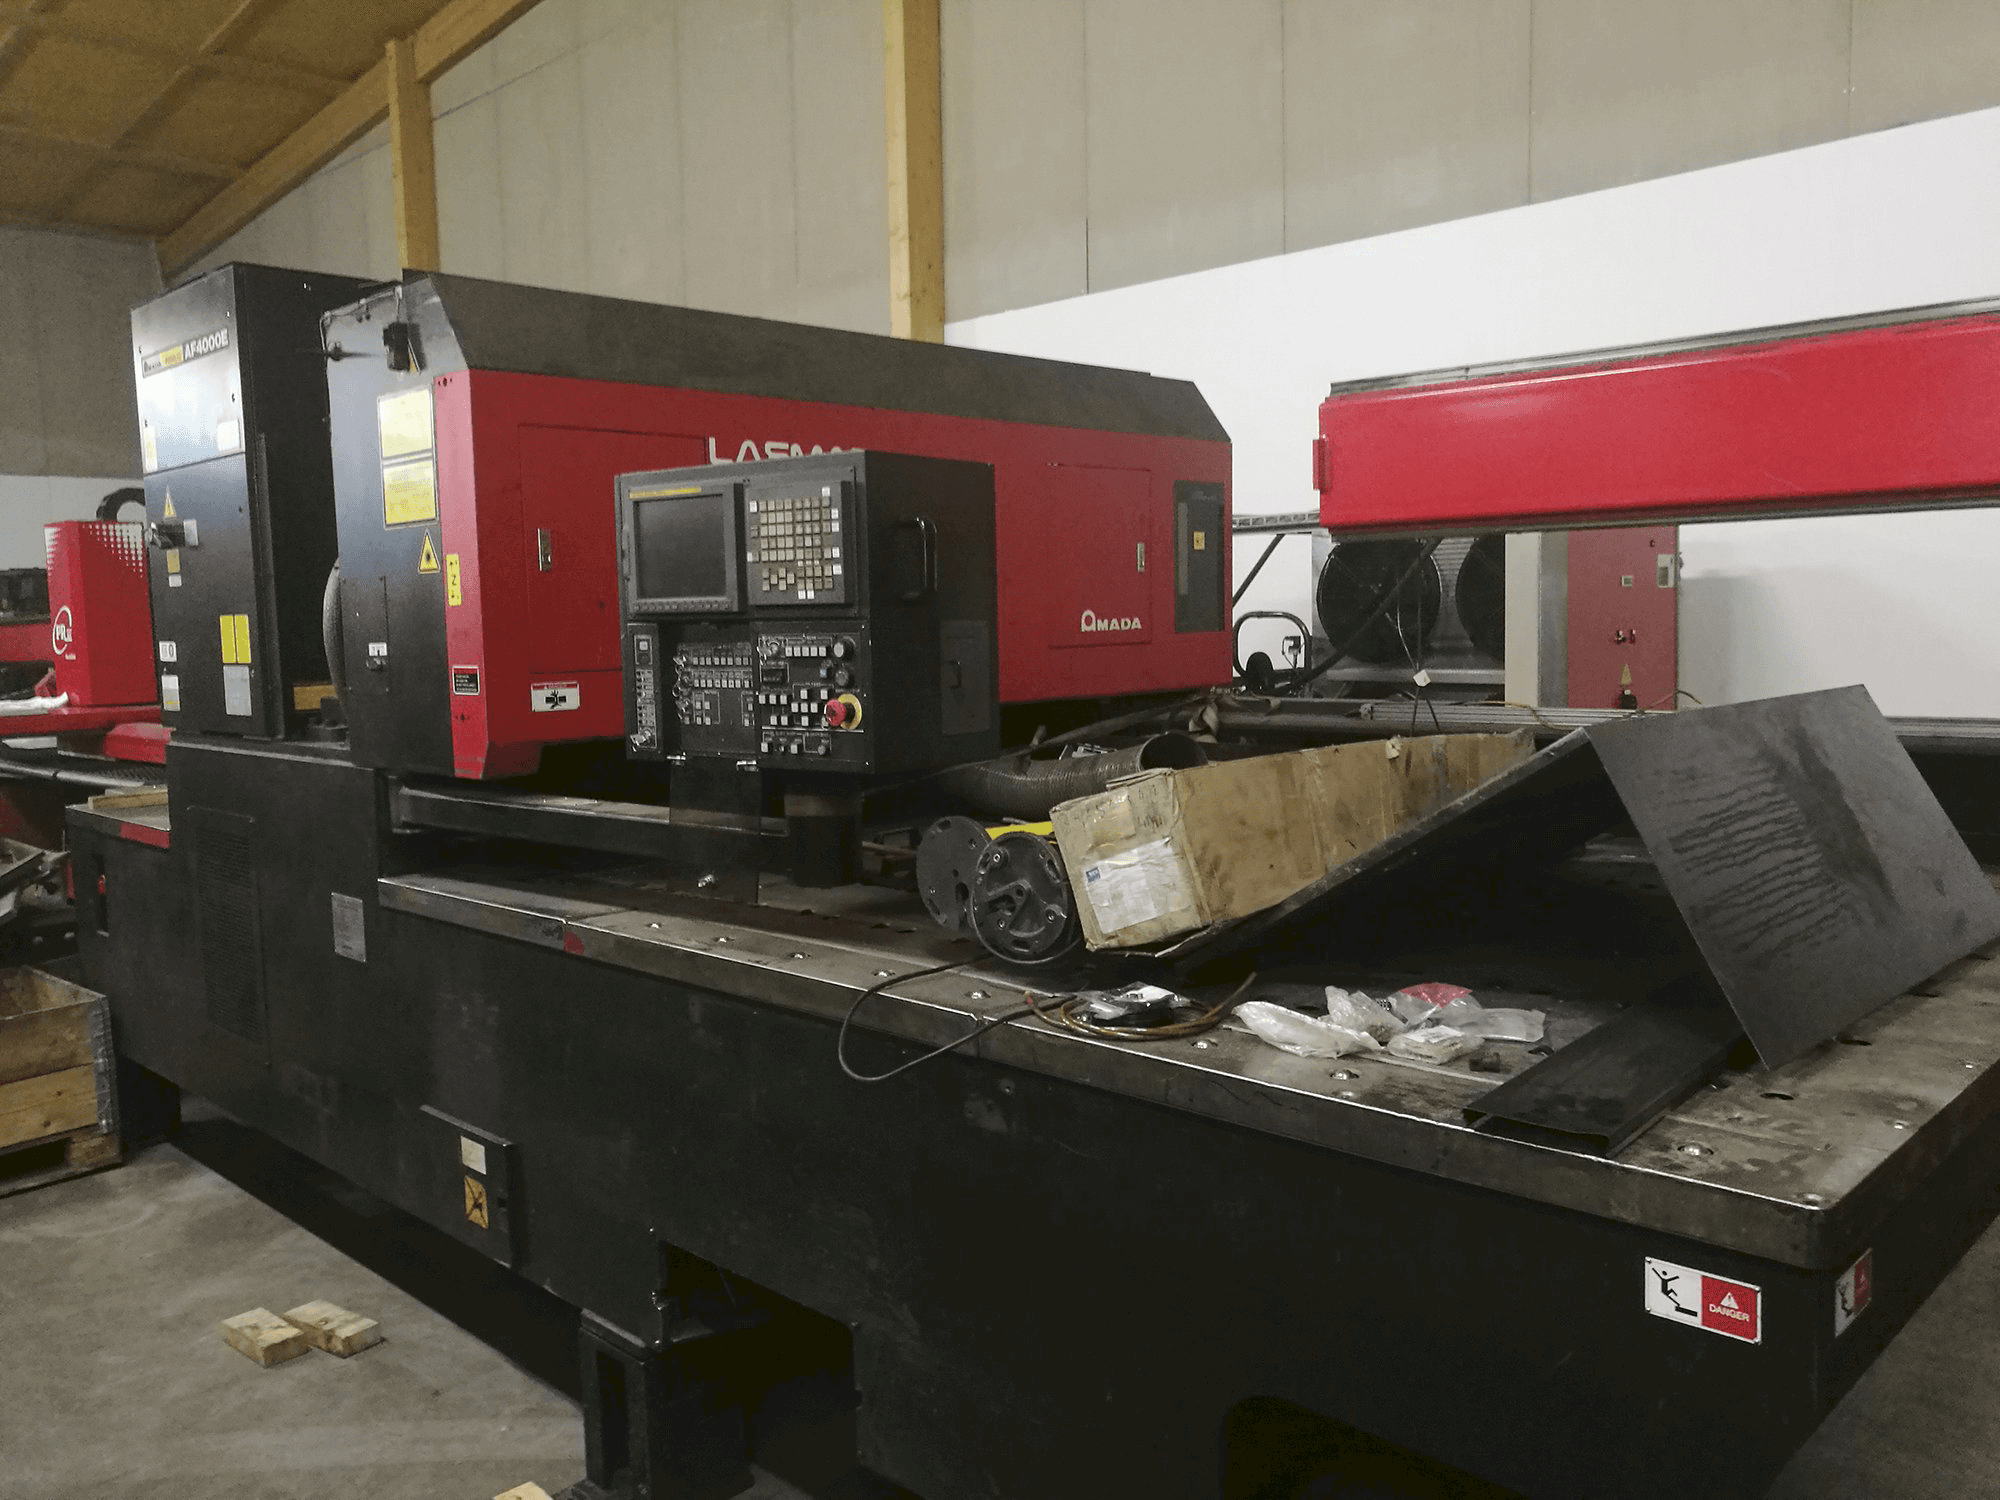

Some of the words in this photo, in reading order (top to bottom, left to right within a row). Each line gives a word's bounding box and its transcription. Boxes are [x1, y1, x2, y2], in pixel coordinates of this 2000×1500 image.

[184, 328, 229, 361] AF4000E
[709, 437, 866, 465] LASM
[1081, 609, 1142, 632] AMADA
[1709, 1304, 1750, 1322] DANGER
